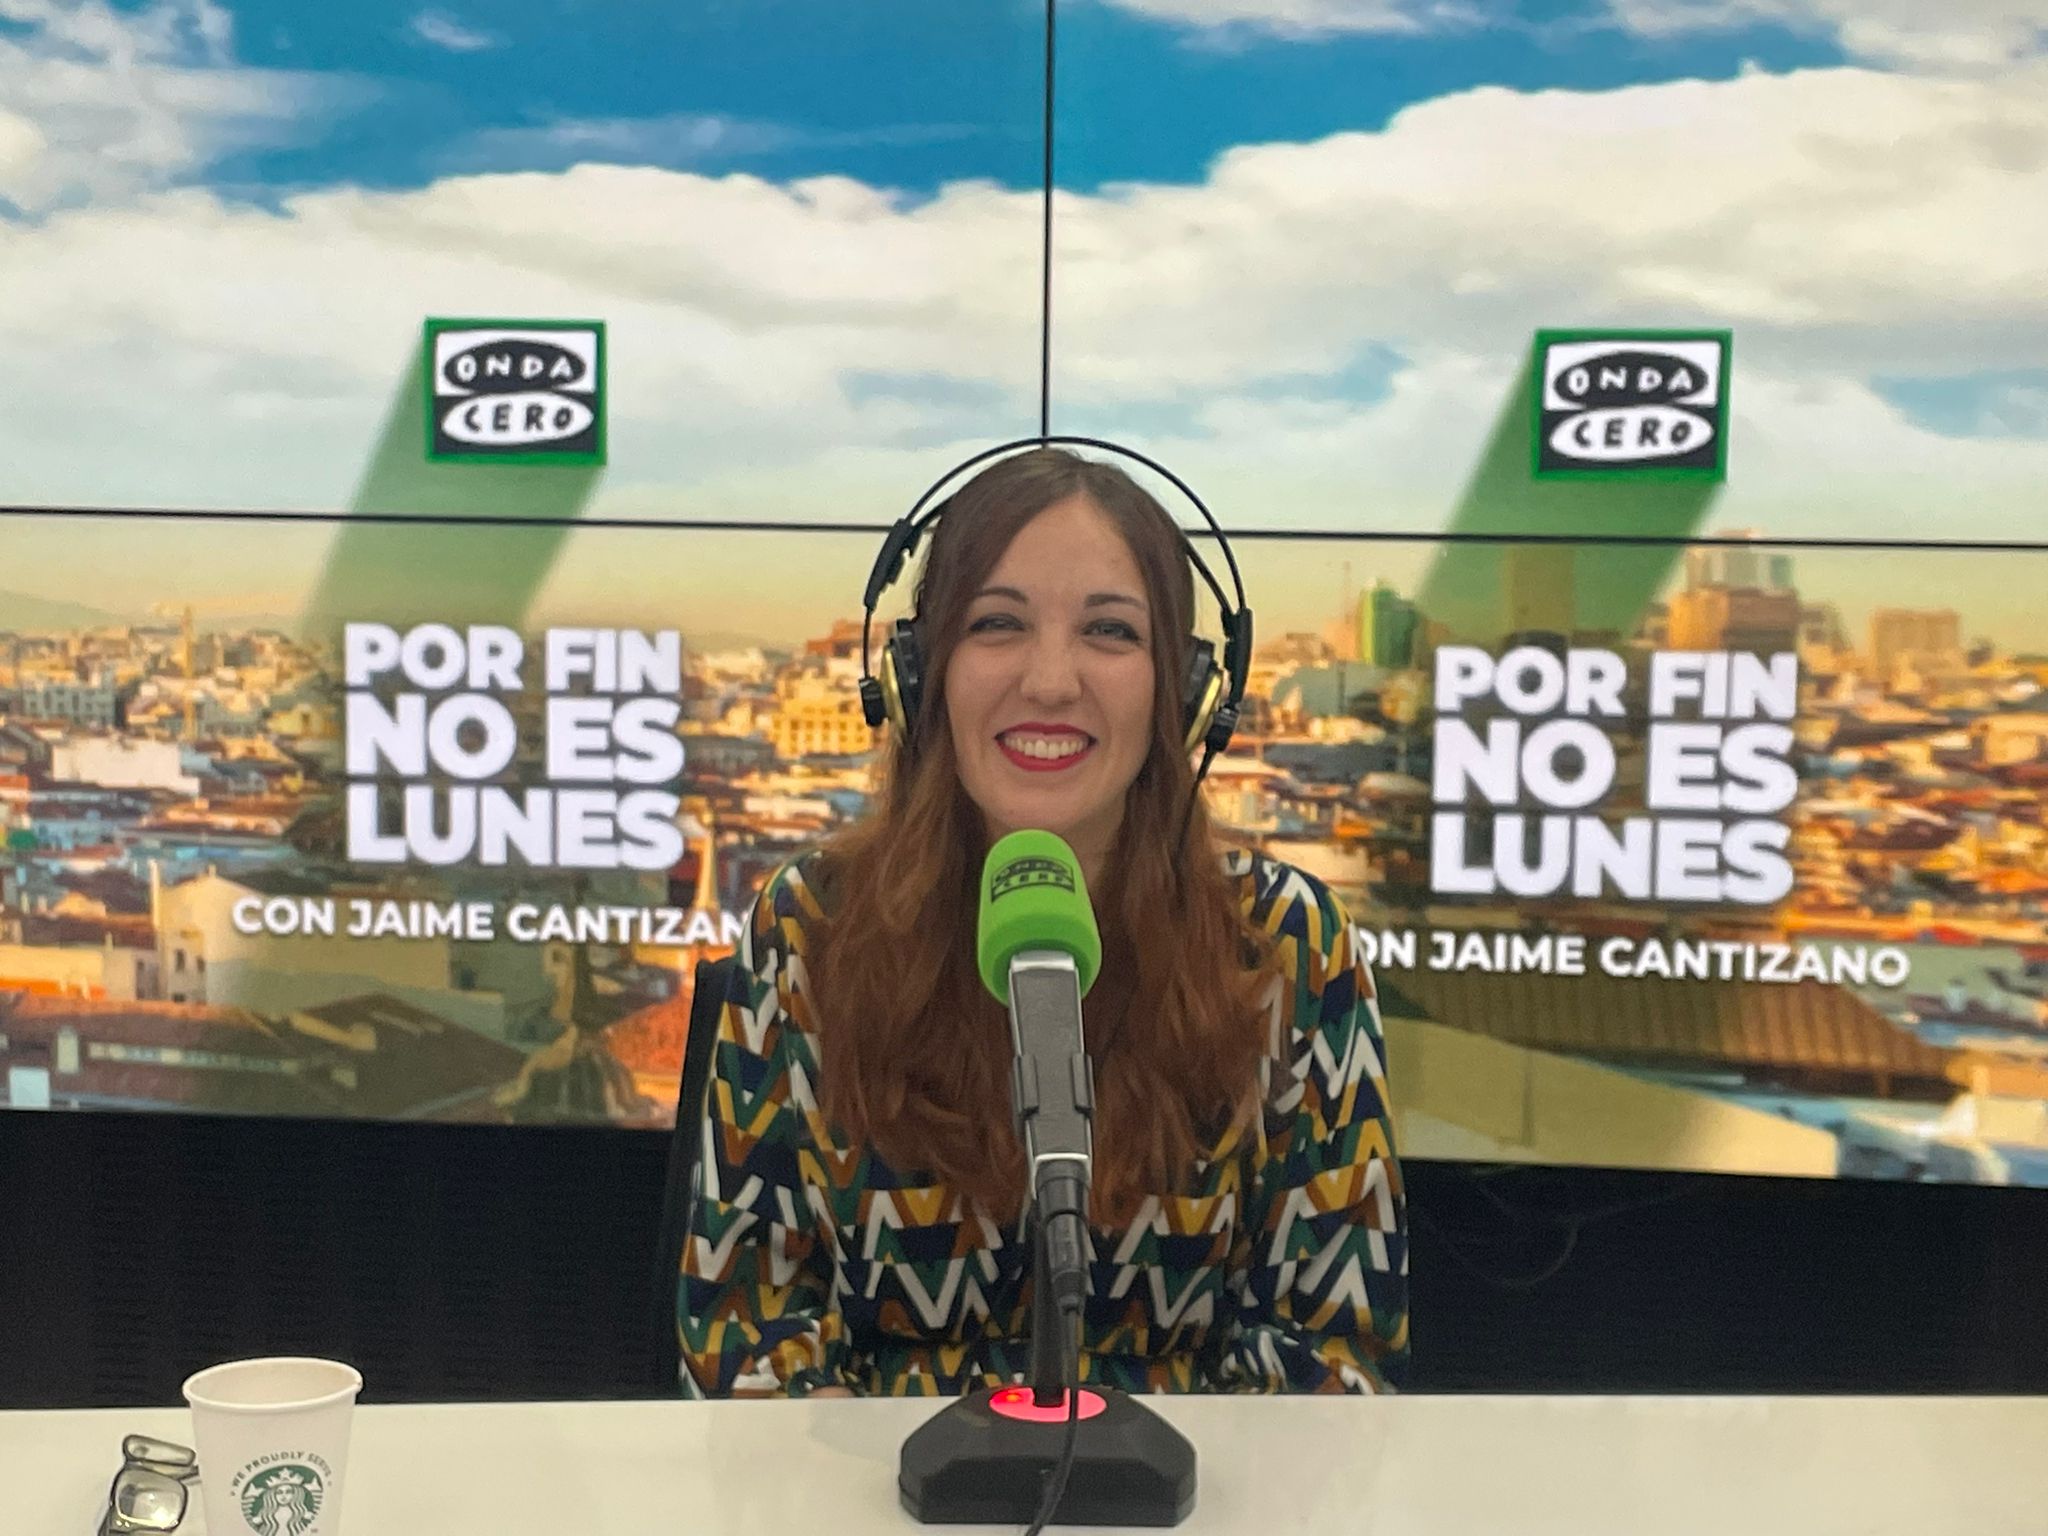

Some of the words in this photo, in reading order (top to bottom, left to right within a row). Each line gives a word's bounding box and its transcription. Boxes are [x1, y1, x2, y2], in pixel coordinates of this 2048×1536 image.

[456, 353, 573, 382] ONDA
[1568, 367, 1692, 396] ONDA
[463, 400, 572, 432] CERO
[1573, 417, 1691, 448] CERO
[345, 622, 524, 690] POR
[546, 628, 681, 693] FIN
[1434, 645, 1627, 717] POR
[1652, 650, 1798, 719] FIN
[346, 691, 517, 779] NO
[546, 697, 685, 784] ES
[1433, 718, 1616, 809] NO
[1648, 722, 1798, 814] ES
[347, 783, 685, 870] LUNES
[1430, 810, 1795, 905] LUNES
[232, 896, 335, 936] CON
[347, 899, 495, 942] JAIME
[507, 902, 749, 946] CANTIZAN
[1428, 930, 1588, 976] JAIME
[1599, 936, 1911, 988] CANTIZANO
[232, 1471, 246, 1487] WE
[245, 1451, 305, 1472] PROUDLY
